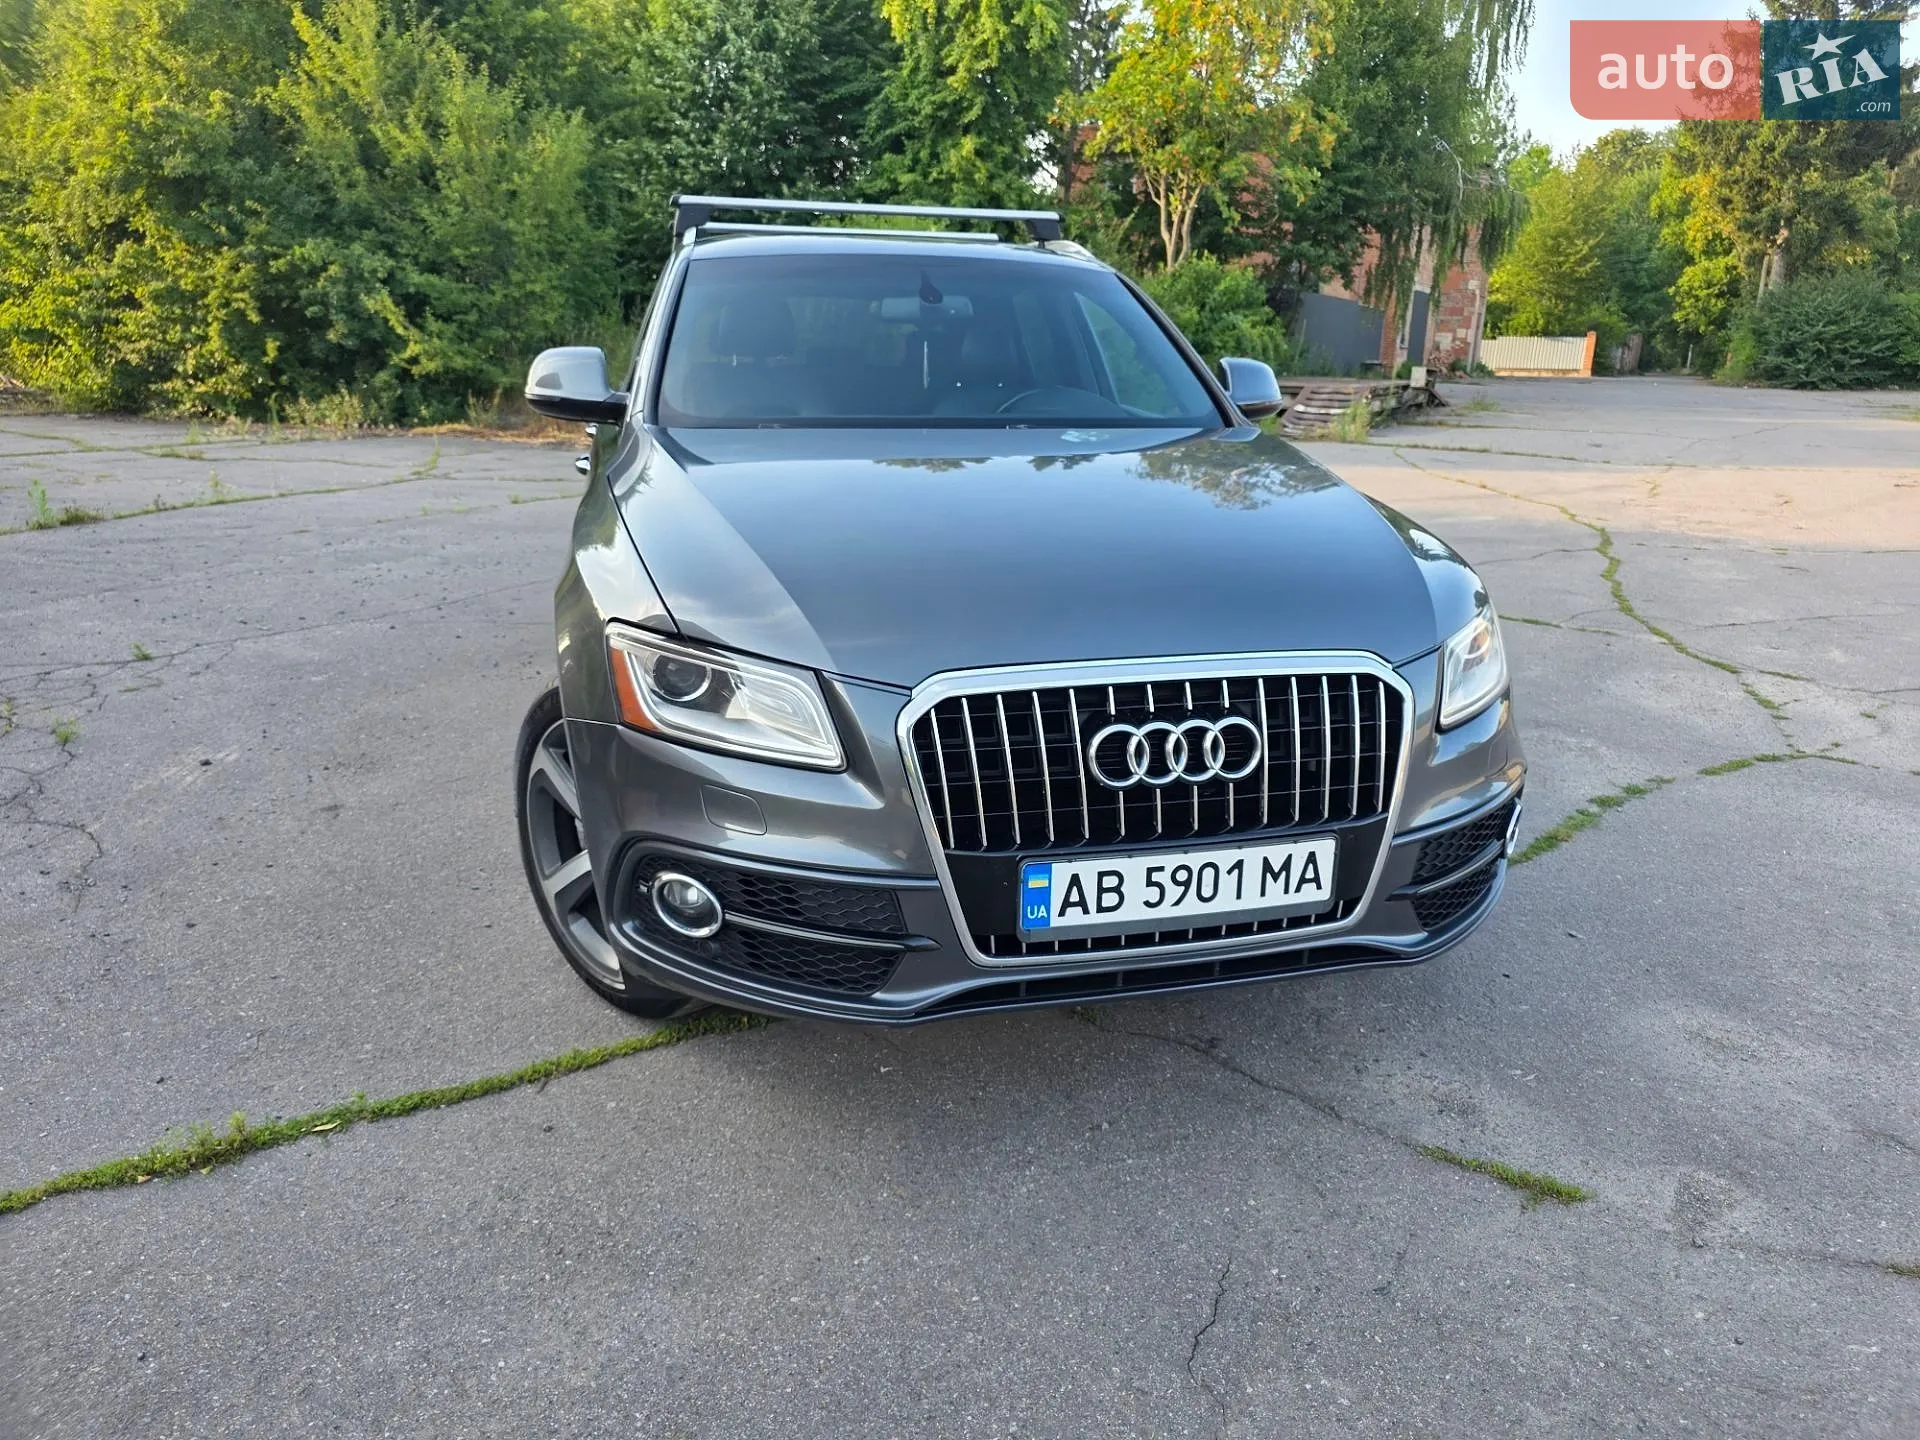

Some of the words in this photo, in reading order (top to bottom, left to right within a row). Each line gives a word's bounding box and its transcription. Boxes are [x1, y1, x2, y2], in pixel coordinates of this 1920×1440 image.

[1057, 869, 1125, 918] AB
[1143, 858, 1244, 909] 5901
[1260, 850, 1323, 897] MA
[1027, 904, 1047, 919] UA
